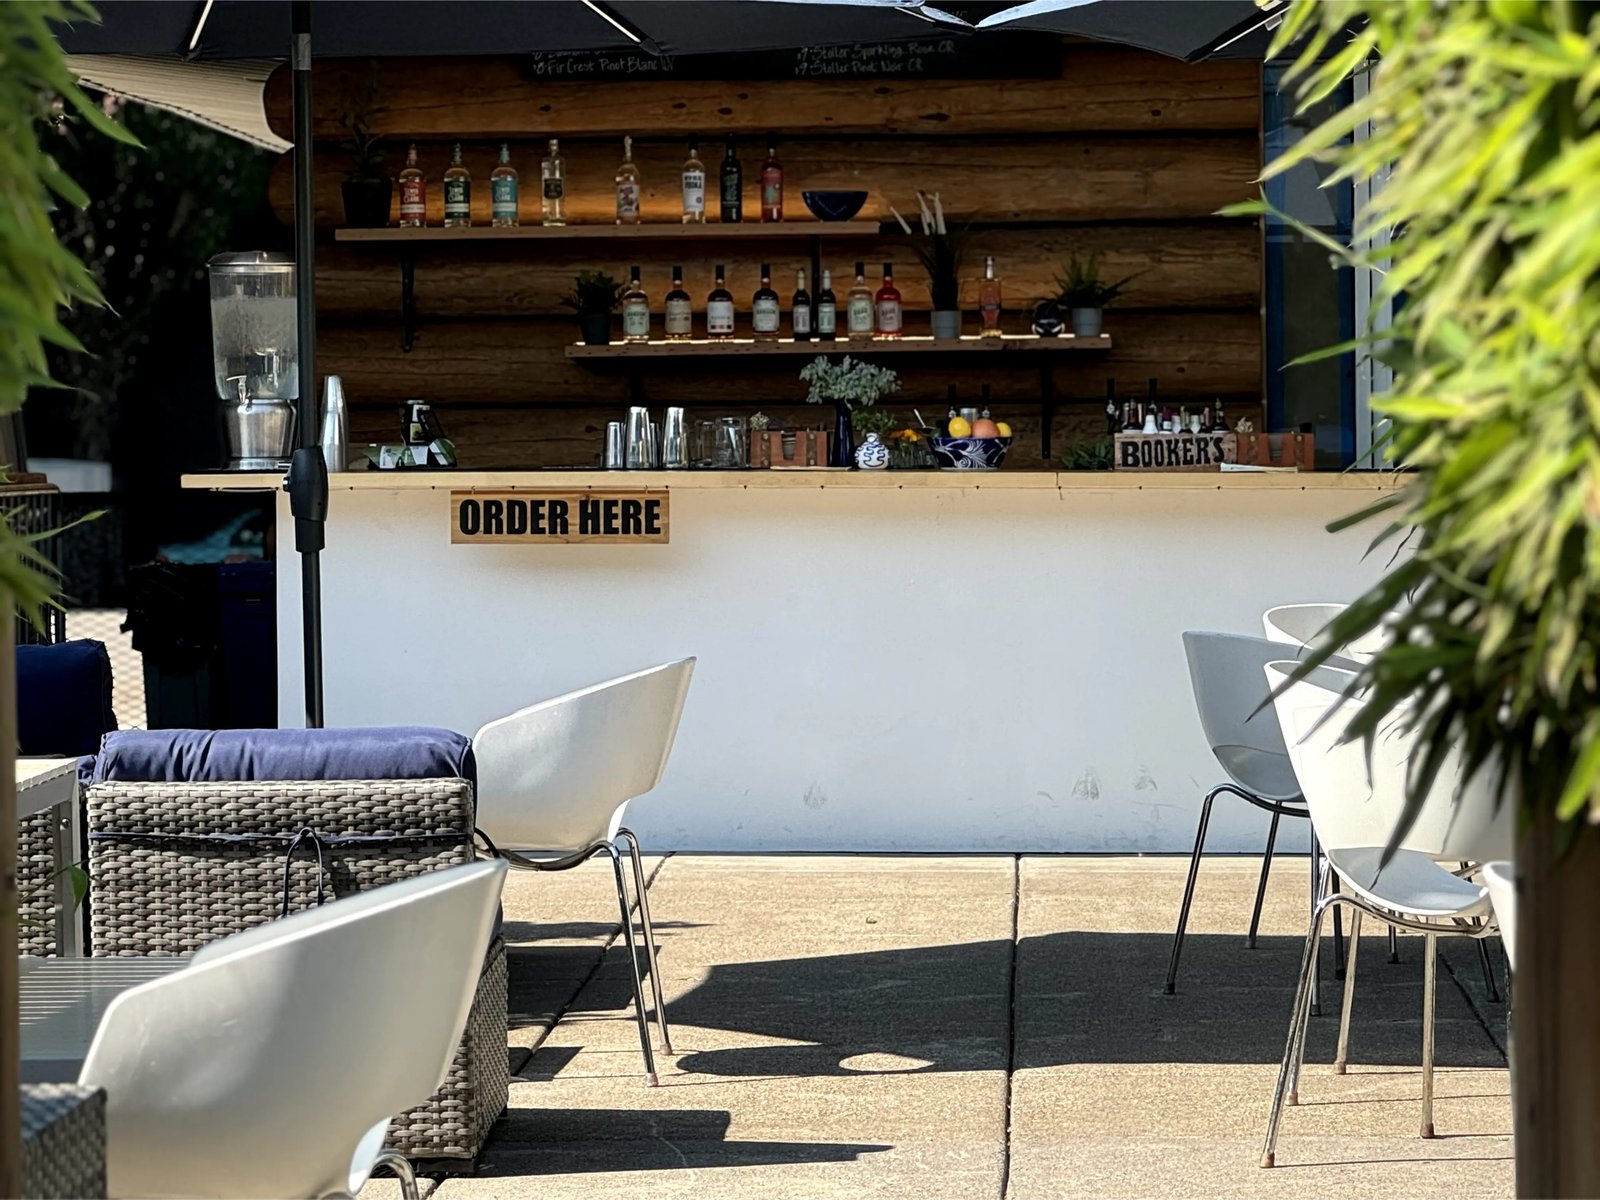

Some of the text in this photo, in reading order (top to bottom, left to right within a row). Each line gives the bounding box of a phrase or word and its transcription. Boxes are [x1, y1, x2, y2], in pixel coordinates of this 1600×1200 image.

[599, 57, 625, 72] Pinot
[626, 56, 658, 73] Blanc
[1121, 436, 1225, 468] BOOKER'S
[460, 499, 661, 535] ORDER HERE
